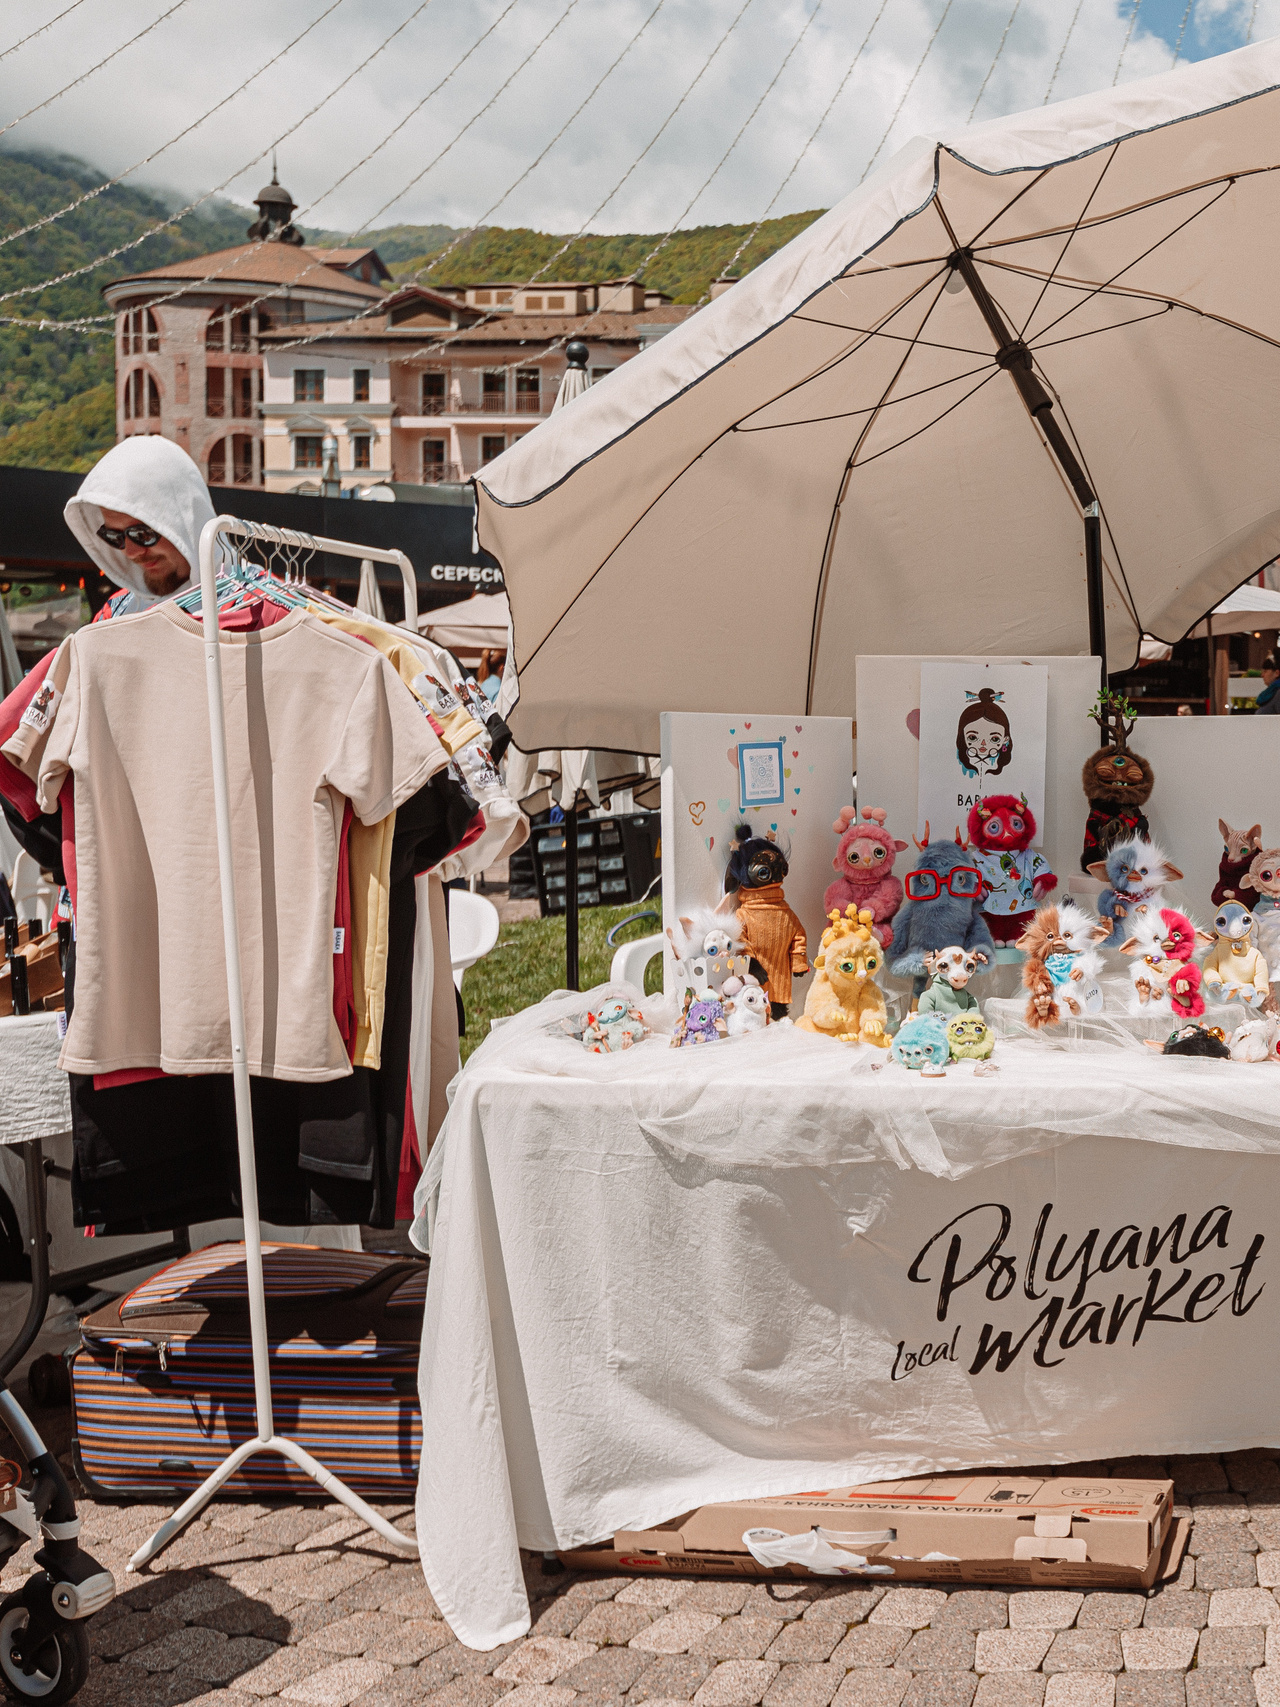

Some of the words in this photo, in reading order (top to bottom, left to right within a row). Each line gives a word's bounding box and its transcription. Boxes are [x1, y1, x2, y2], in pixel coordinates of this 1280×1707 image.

[907, 1203, 1232, 1321] Polyana
[891, 1325, 961, 1380] Local
[784, 1501, 910, 1511] ГАРДЕРОБНАЯ
[917, 1505, 1003, 1513] ВЕШАЛКА
